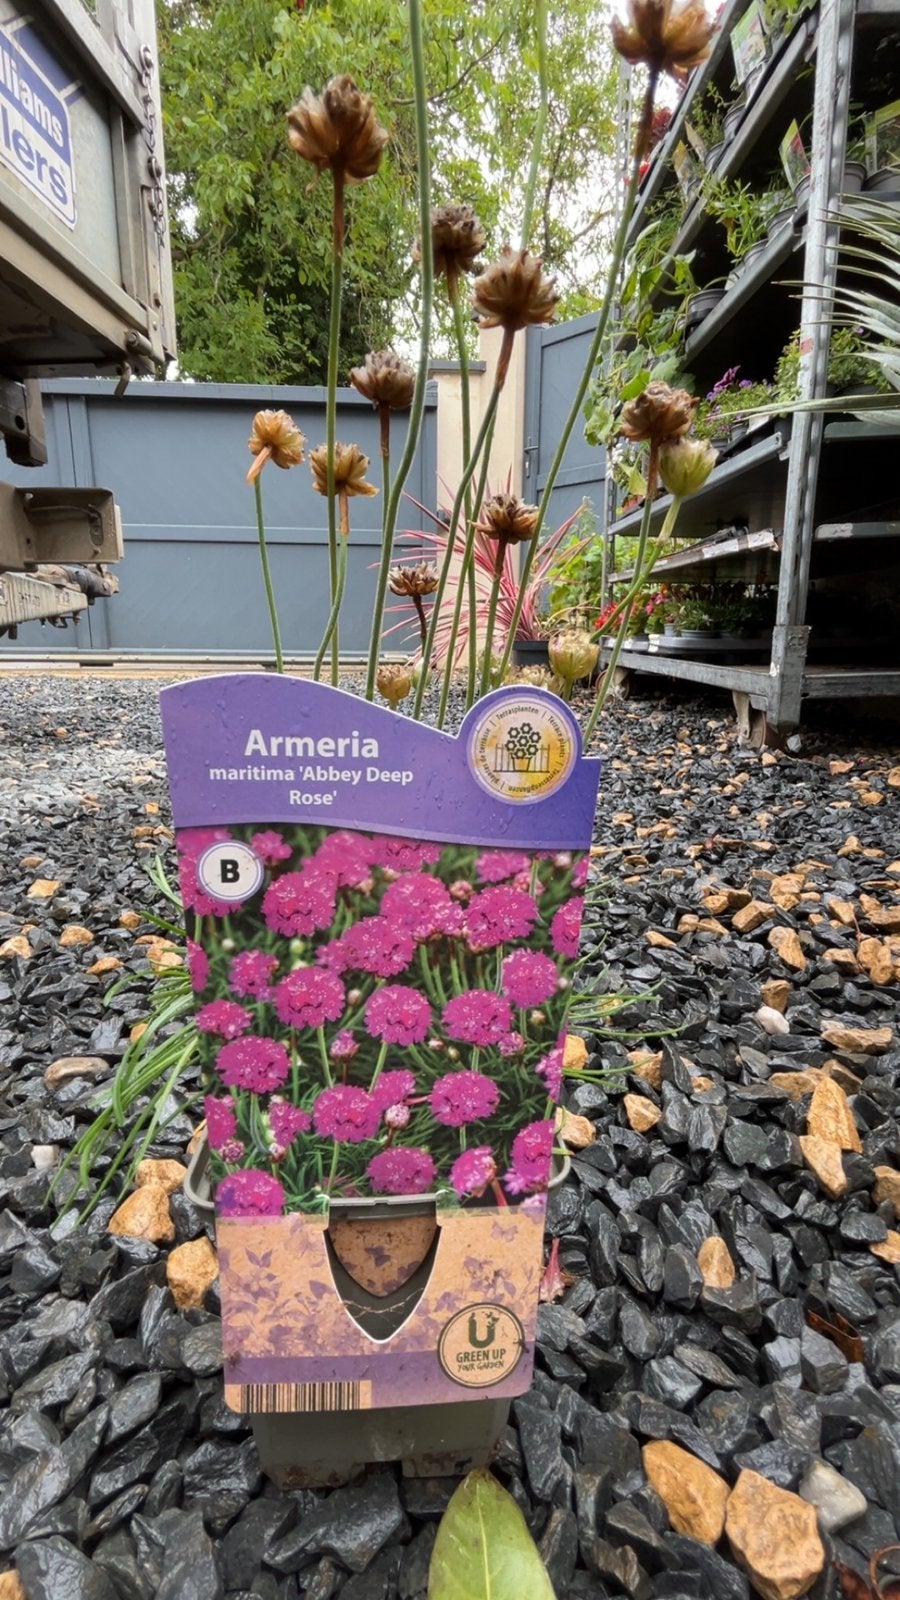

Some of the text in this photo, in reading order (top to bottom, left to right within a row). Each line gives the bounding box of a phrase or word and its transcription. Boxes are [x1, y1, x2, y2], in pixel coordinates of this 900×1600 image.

[496, 706, 539, 720] Terrasplanten
[244, 729, 379, 758] Armeria
[209, 765, 414, 786] maritima 'Abbey Deep
[289, 790, 337, 805] Rose'
[220, 860, 240, 884] B
[456, 1348, 506, 1363] GREEN UP
[477, 1361, 504, 1370] GARDEN
